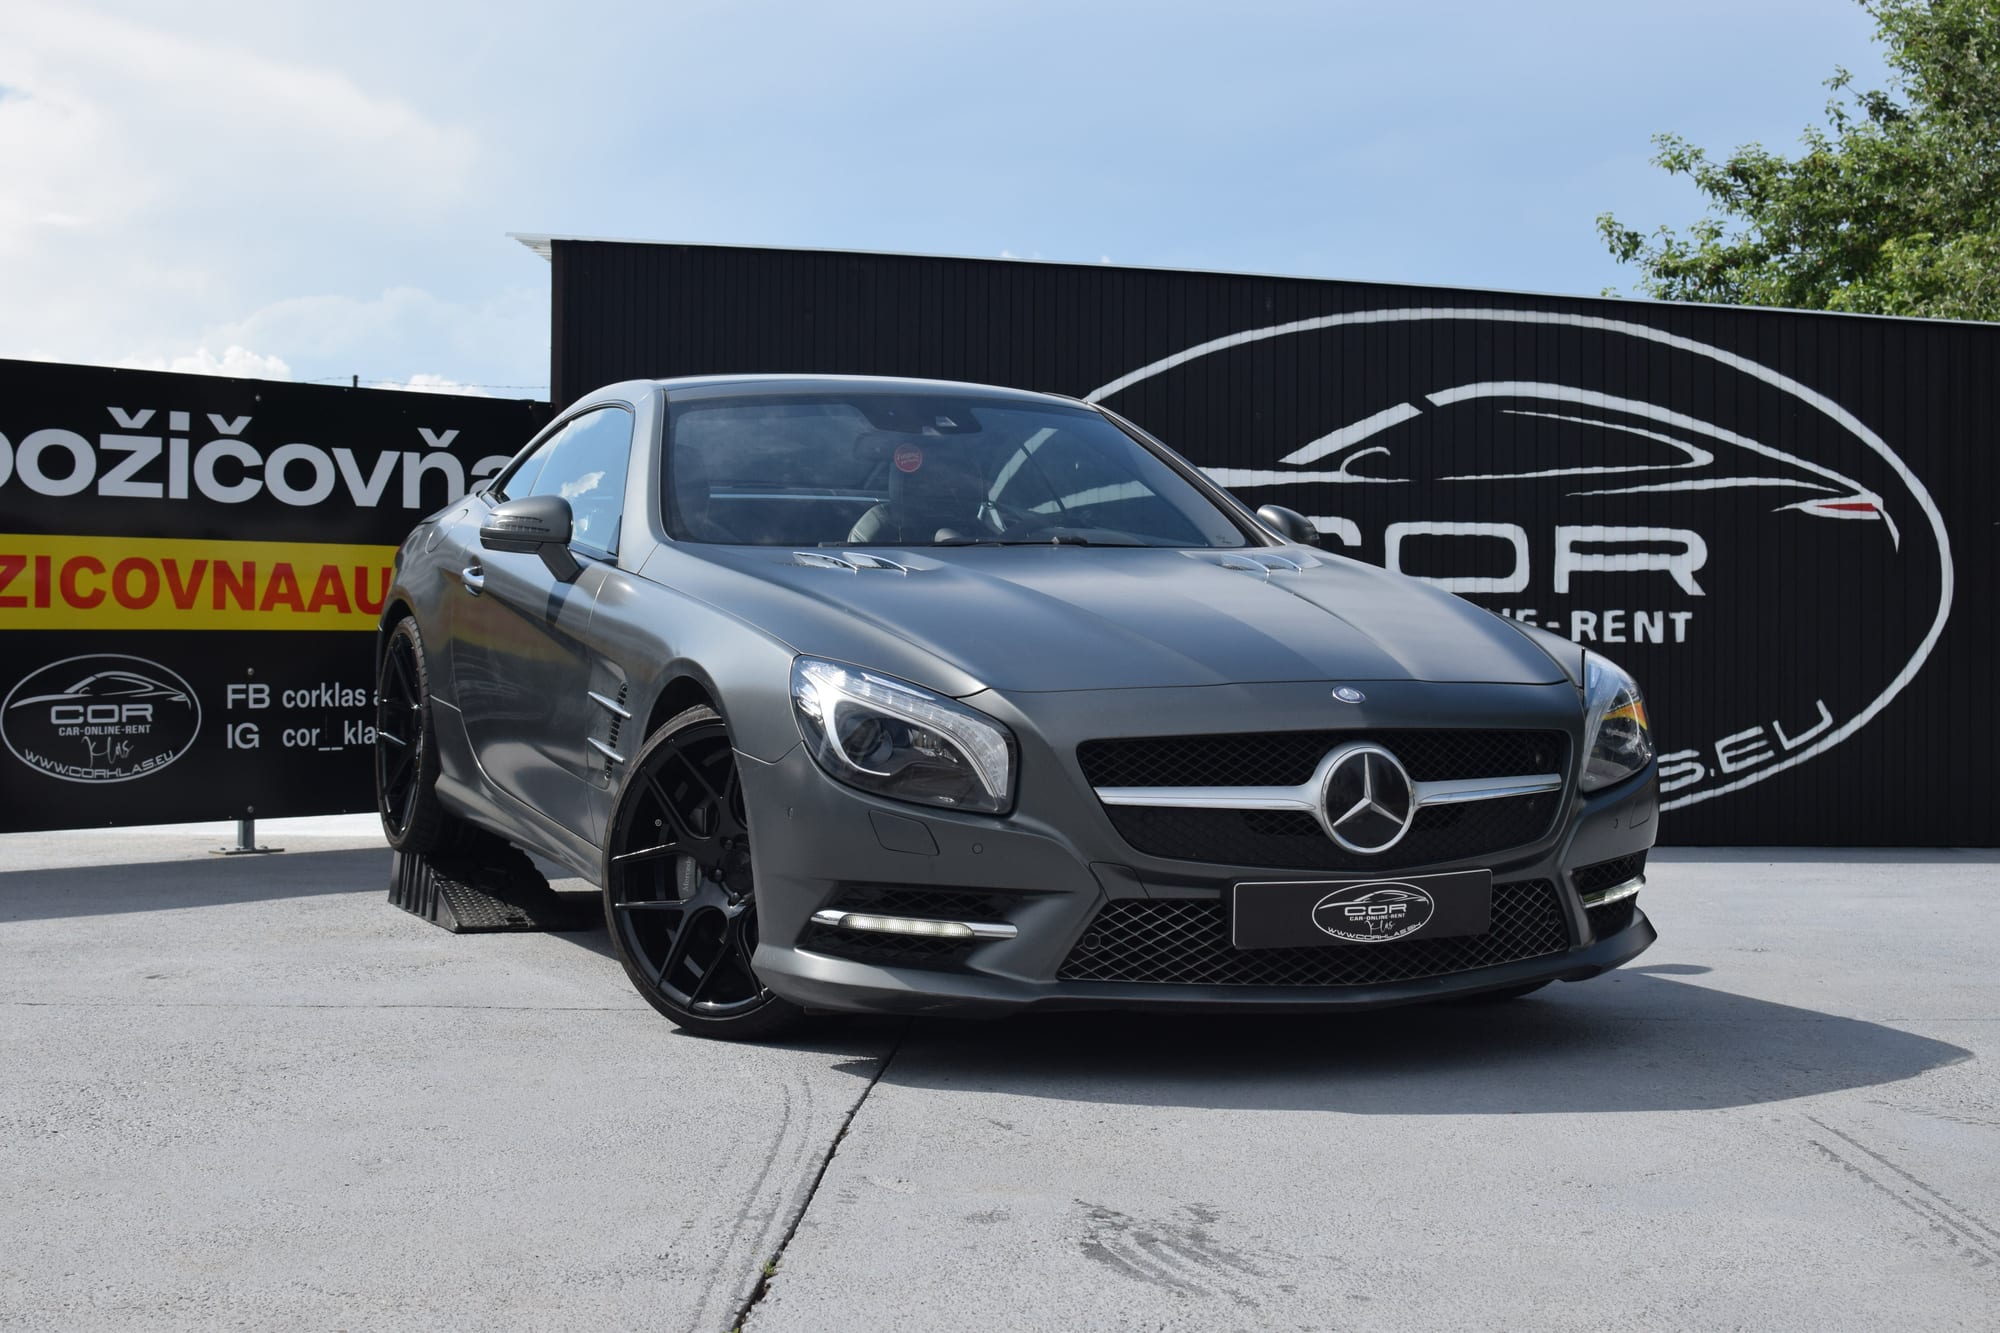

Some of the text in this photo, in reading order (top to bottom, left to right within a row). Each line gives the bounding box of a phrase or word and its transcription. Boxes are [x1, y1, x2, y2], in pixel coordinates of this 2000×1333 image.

[1307, 515, 1708, 596] OR
[227, 683, 271, 709] FB
[282, 682, 366, 708] corklas
[50, 703, 153, 725] COR
[58, 724, 151, 736] CAR-ONLINE-RENT
[227, 719, 379, 751] IG cor__kla
[25, 748, 175, 778] WWW.CORKLAS.EU
[1344, 903, 1407, 916] COR
